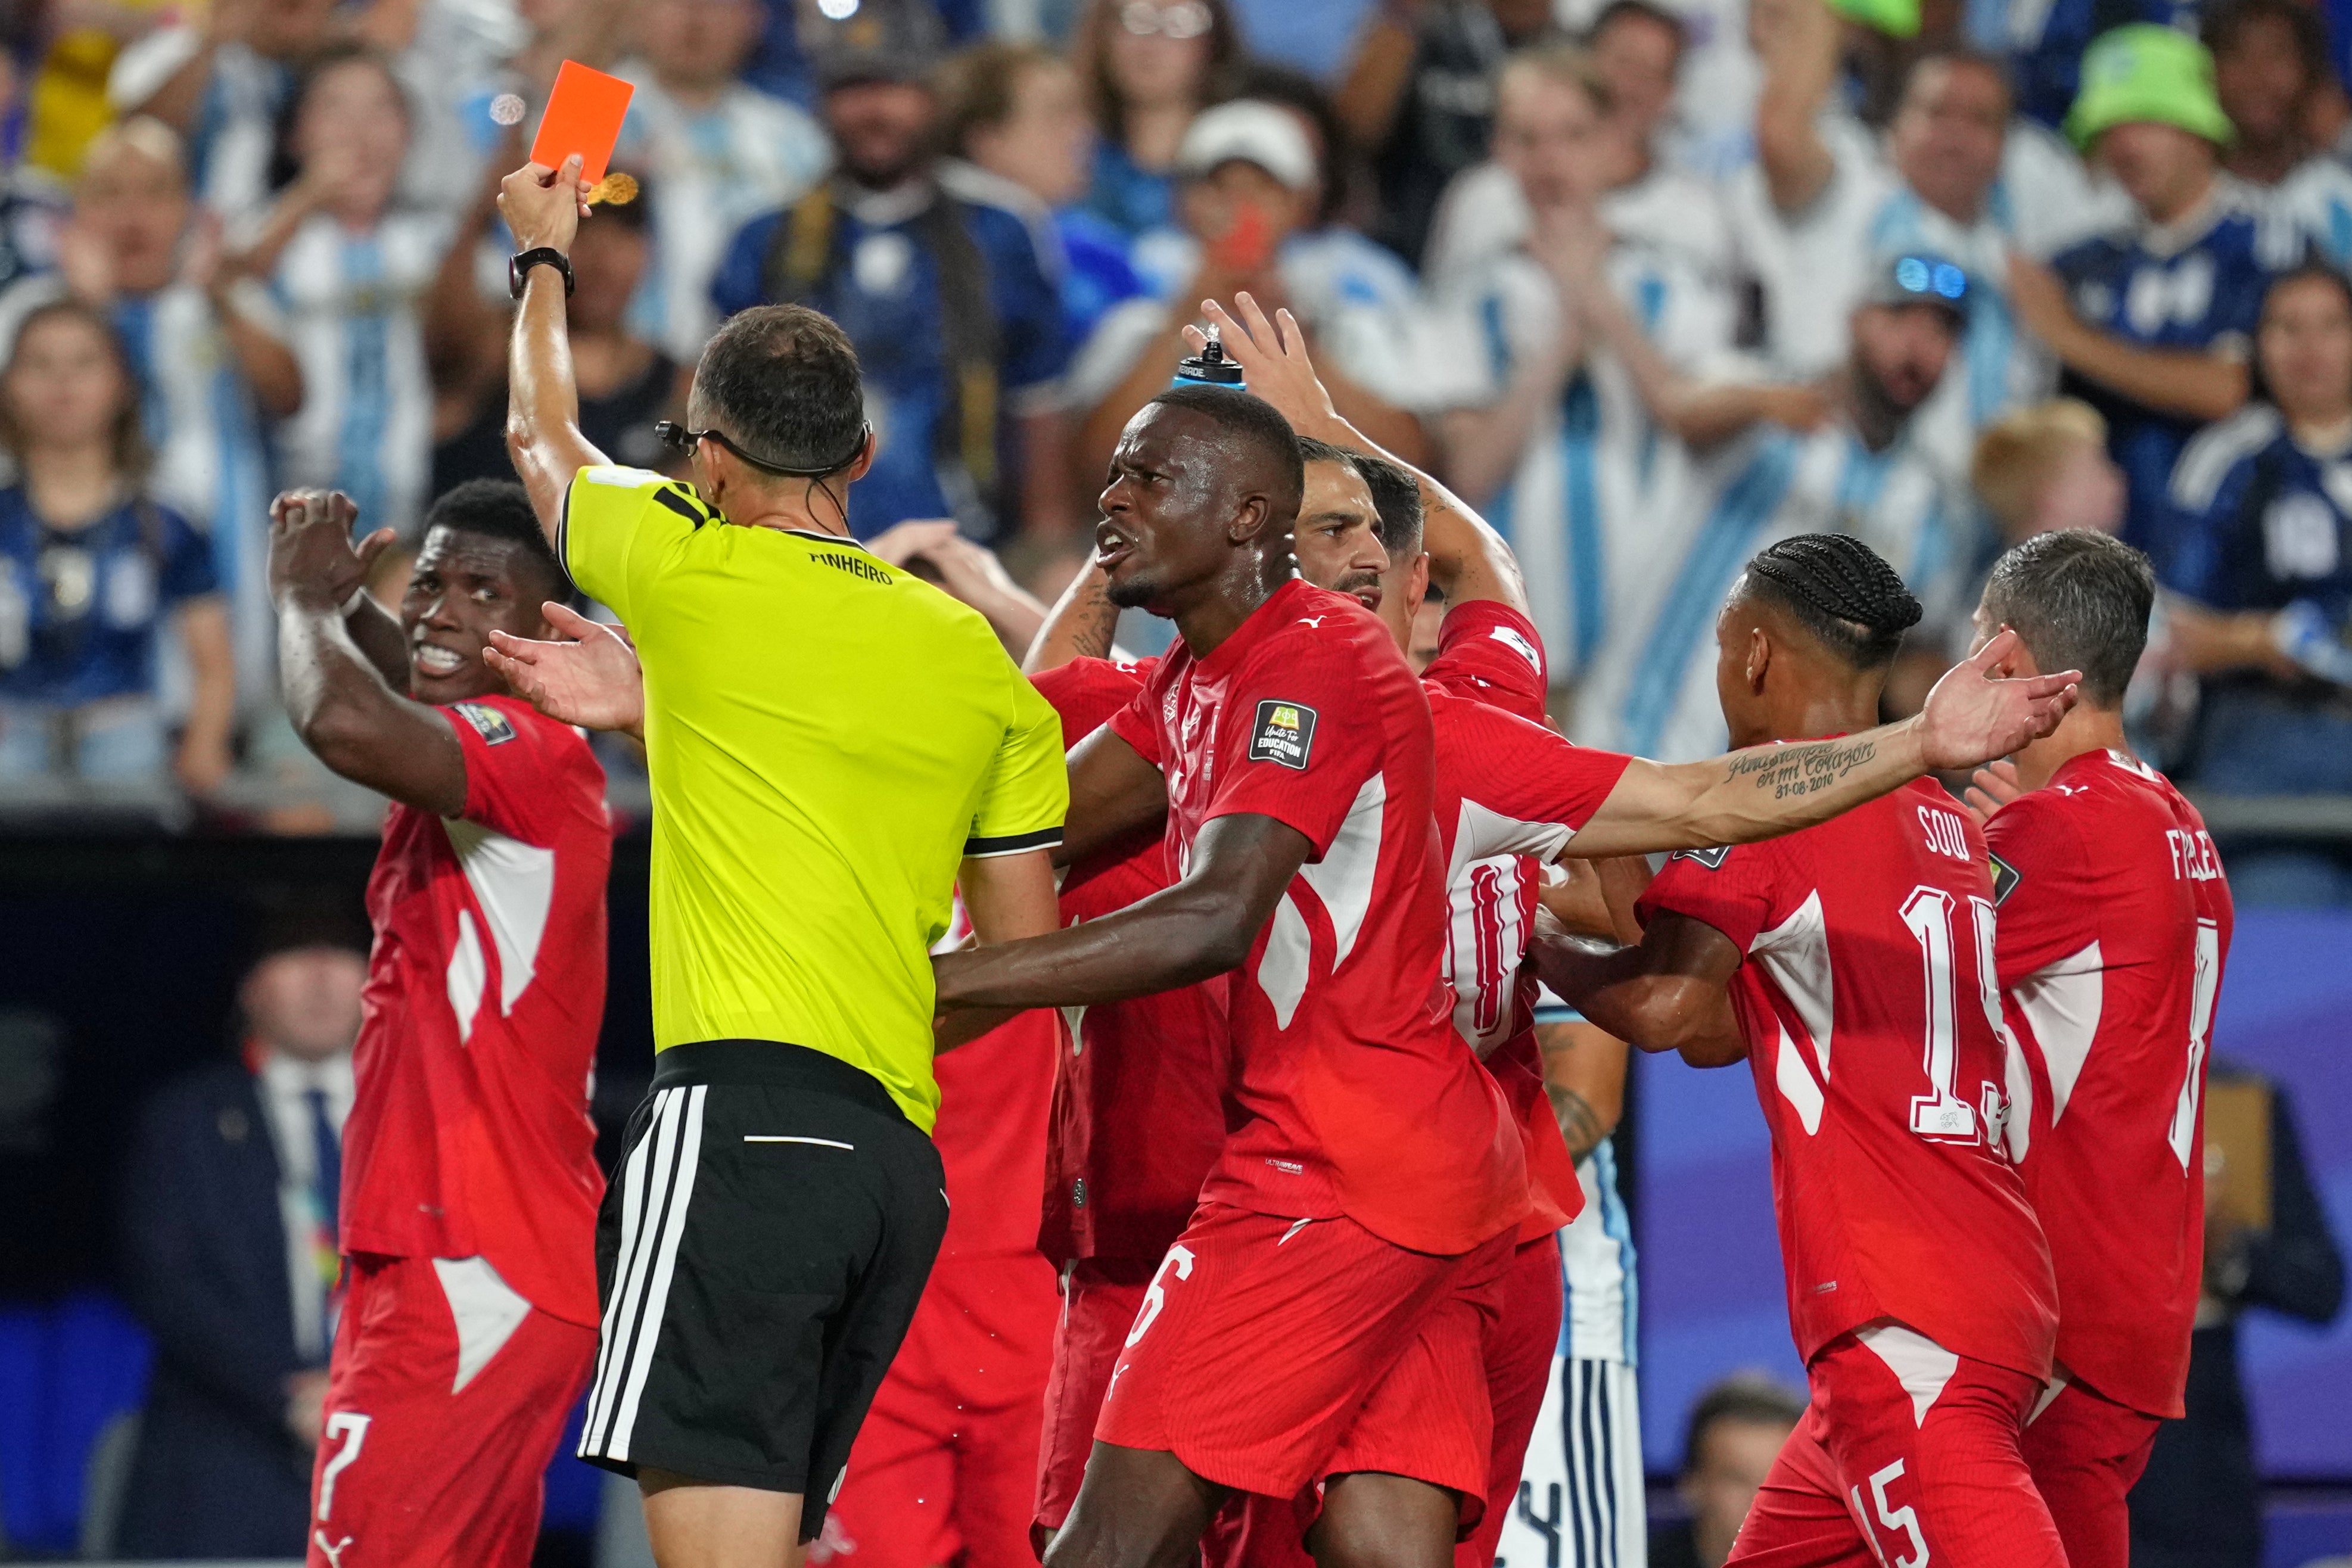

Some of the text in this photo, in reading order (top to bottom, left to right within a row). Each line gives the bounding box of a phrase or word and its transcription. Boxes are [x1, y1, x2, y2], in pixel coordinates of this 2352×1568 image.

[1257, 738, 1301, 758] EDUCATION
[1264, 725, 1299, 742] Unite For
[1269, 749, 1285, 760] FIFA
[1917, 805, 1970, 861] SOW
[1124, 1244, 1196, 1349] 6
[318, 1411, 372, 1522] 7
[1850, 1457, 1930, 1568] 15
